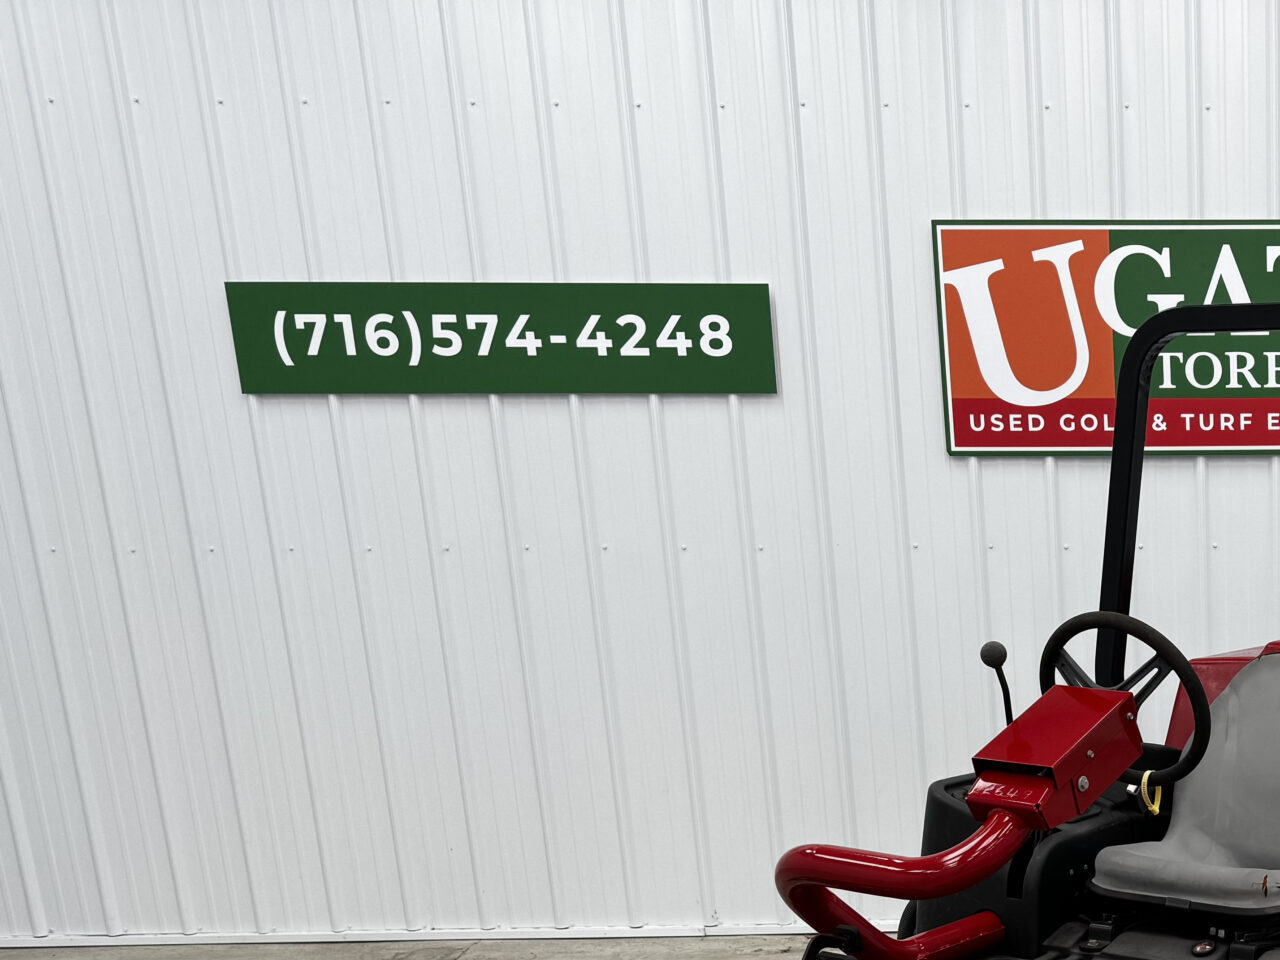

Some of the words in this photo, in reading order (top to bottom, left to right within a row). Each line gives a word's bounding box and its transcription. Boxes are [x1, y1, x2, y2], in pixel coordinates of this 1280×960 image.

[274, 311, 732, 366] (716)574-4248
[970, 414, 1044, 431] USED
[1060, 414, 1114, 431] GOL
[1152, 414, 1166, 431] &
[1181, 413, 1252, 430] TURF
